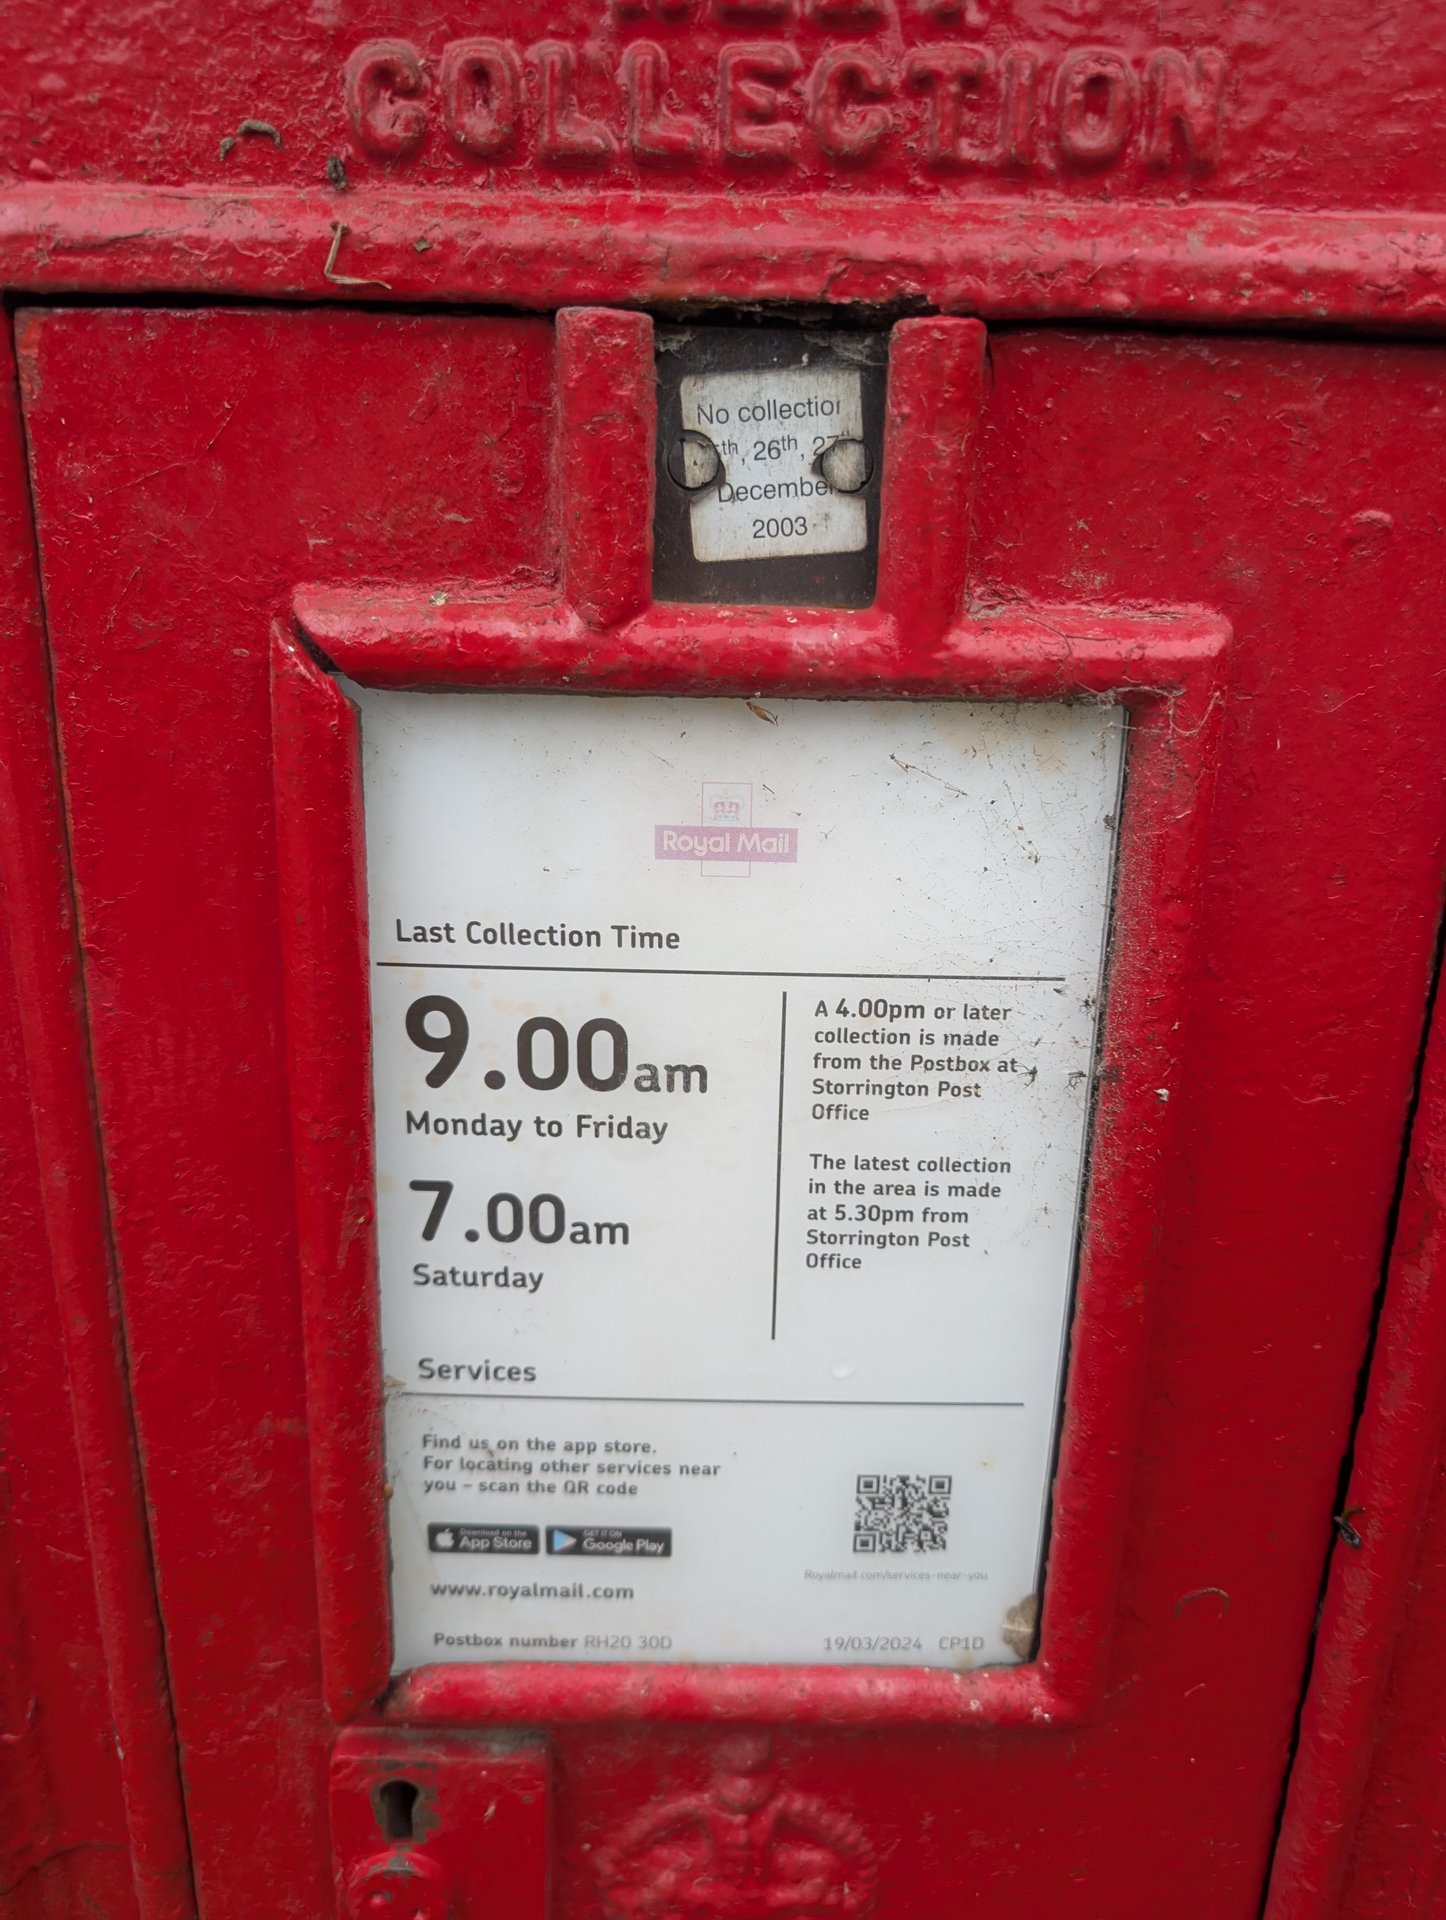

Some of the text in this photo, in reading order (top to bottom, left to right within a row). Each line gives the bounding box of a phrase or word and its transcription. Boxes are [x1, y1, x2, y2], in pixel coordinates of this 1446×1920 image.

[343, 38, 1228, 168] COLLECTION
[697, 403, 729, 425] No
[753, 434, 805, 461] 26th,
[752, 516, 808, 539] 2003
[663, 830, 790, 856] Royal Mail
[396, 918, 681, 950] Last Collection Time
[814, 998, 1012, 1023] A 4.00pm or later
[405, 995, 708, 1094] 9.00am
[814, 1028, 999, 1047] collection is made
[813, 1053, 1018, 1073] from the Postbox at
[812, 1078, 982, 1099] Storrington Post
[811, 1103, 870, 1121] Office
[406, 1110, 668, 1144] Monday to Friday
[809, 1153, 1011, 1173] The latest collection
[808, 1178, 1002, 1198] in the area is made
[409, 1179, 630, 1245] 7.00am
[807, 1204, 969, 1226] at 5.30pm from
[806, 1229, 971, 1249] Storrington Post
[806, 1253, 862, 1270] Office
[413, 1263, 544, 1294] Saturday
[418, 1357, 537, 1382] Services
[422, 1433, 657, 1455] Find us on the app store.
[423, 1455, 722, 1476] For locating other services near
[424, 1479, 456, 1493] you
[479, 1480, 519, 1493] scan
[527, 1478, 556, 1494] the
[564, 1480, 589, 1494] QR
[596, 1481, 638, 1495] code
[460, 1528, 500, 1536] Download
[515, 1529, 528, 1537] the
[583, 1529, 623, 1538] GET IT ON
[459, 1536, 532, 1551] App Store
[583, 1537, 665, 1554] Google Play
[430, 1582, 634, 1600] www.royalmail.com
[434, 1632, 503, 1648] Postbox
[509, 1633, 578, 1649] number
[584, 1634, 632, 1649] RH20
[823, 1635, 985, 1650] 19/03/2024 CP1D
